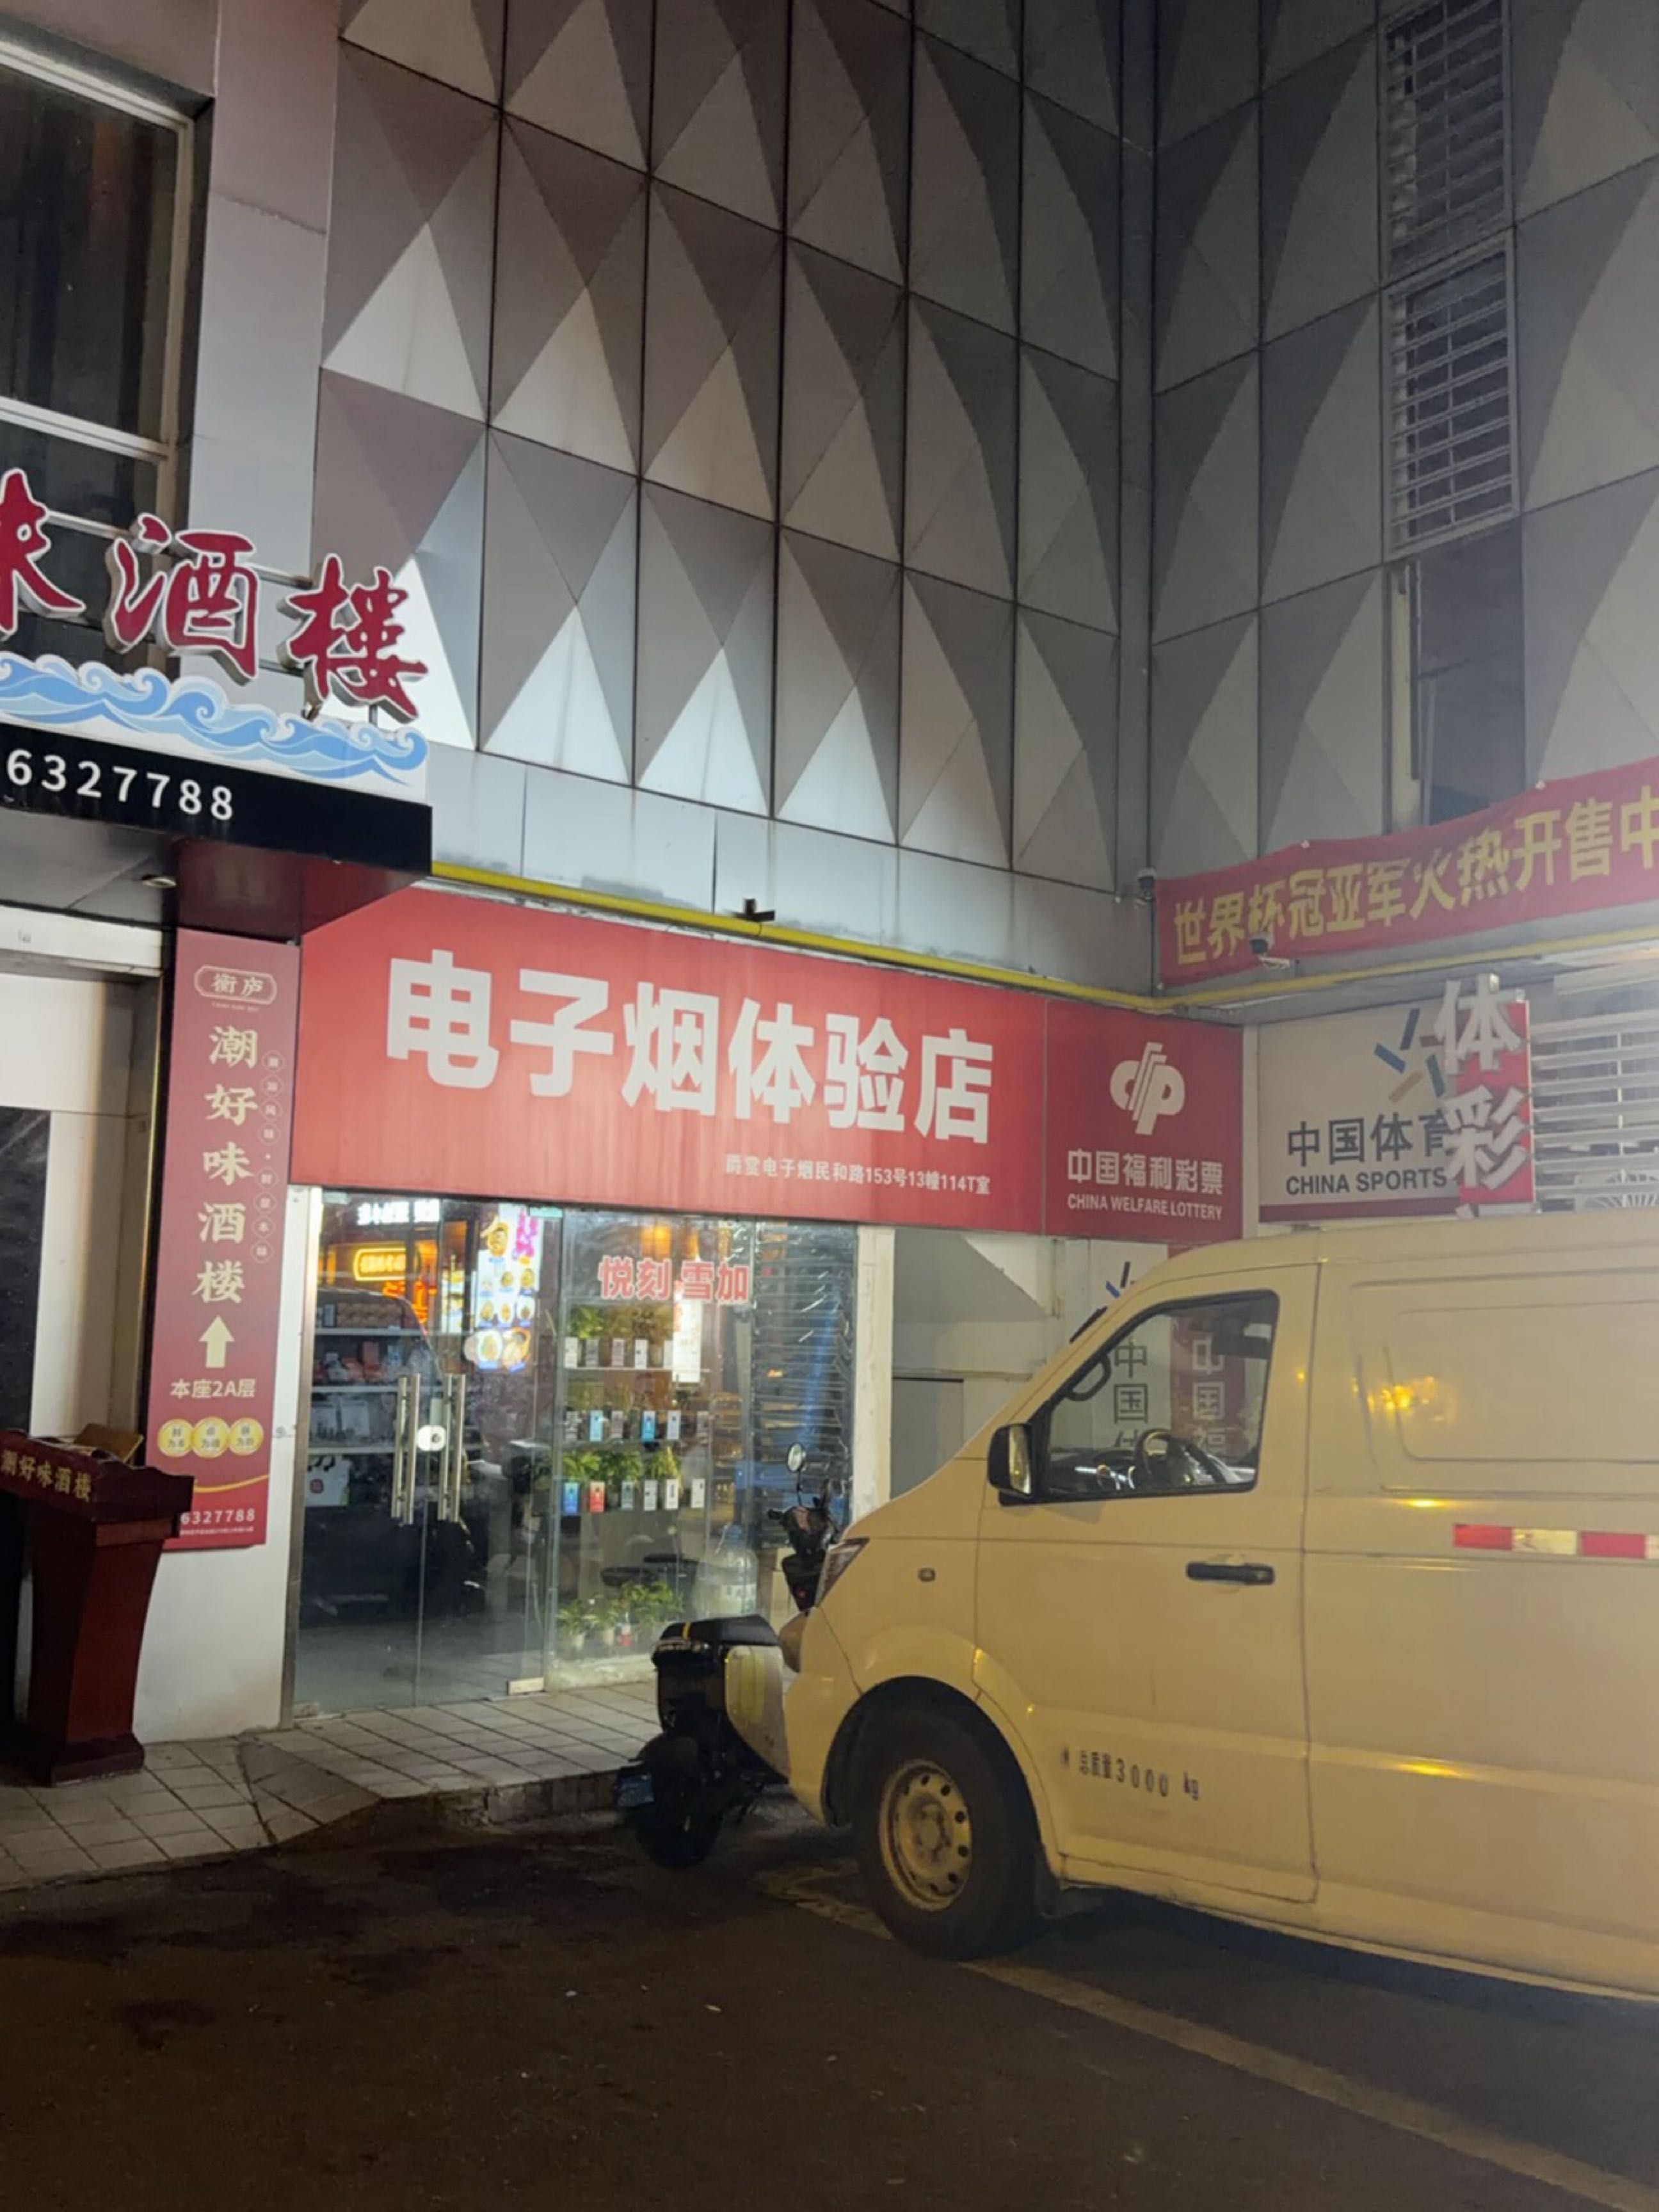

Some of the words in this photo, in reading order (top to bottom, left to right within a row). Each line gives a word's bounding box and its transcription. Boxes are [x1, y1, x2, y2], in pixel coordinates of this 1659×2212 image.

[6, 748, 234, 820] 6327788
[1174, 785, 1659, 965] 世界杯冠亚军火热开售中
[387, 949, 993, 1143] 电子烟体验店
[1434, 973, 1527, 1190] 体彩
[193, 1025, 258, 1304] 潮好味酒楼
[1287, 1108, 1459, 1167] 中国体育
[1068, 1148, 1223, 1194] 中国福利彩票
[1286, 1175, 1350, 1195] CHINA
[1356, 1167, 1447, 1192] SPORTS
[1068, 1193, 1108, 1209] CHINA
[1110, 1195, 1169, 1214] WELFARE
[1170, 1201, 1223, 1221] LOTTERY
[597, 1254, 670, 1301] 悦刻
[680, 1260, 750, 1304] 雪加
[170, 1379, 257, 1399] 本座2A层
